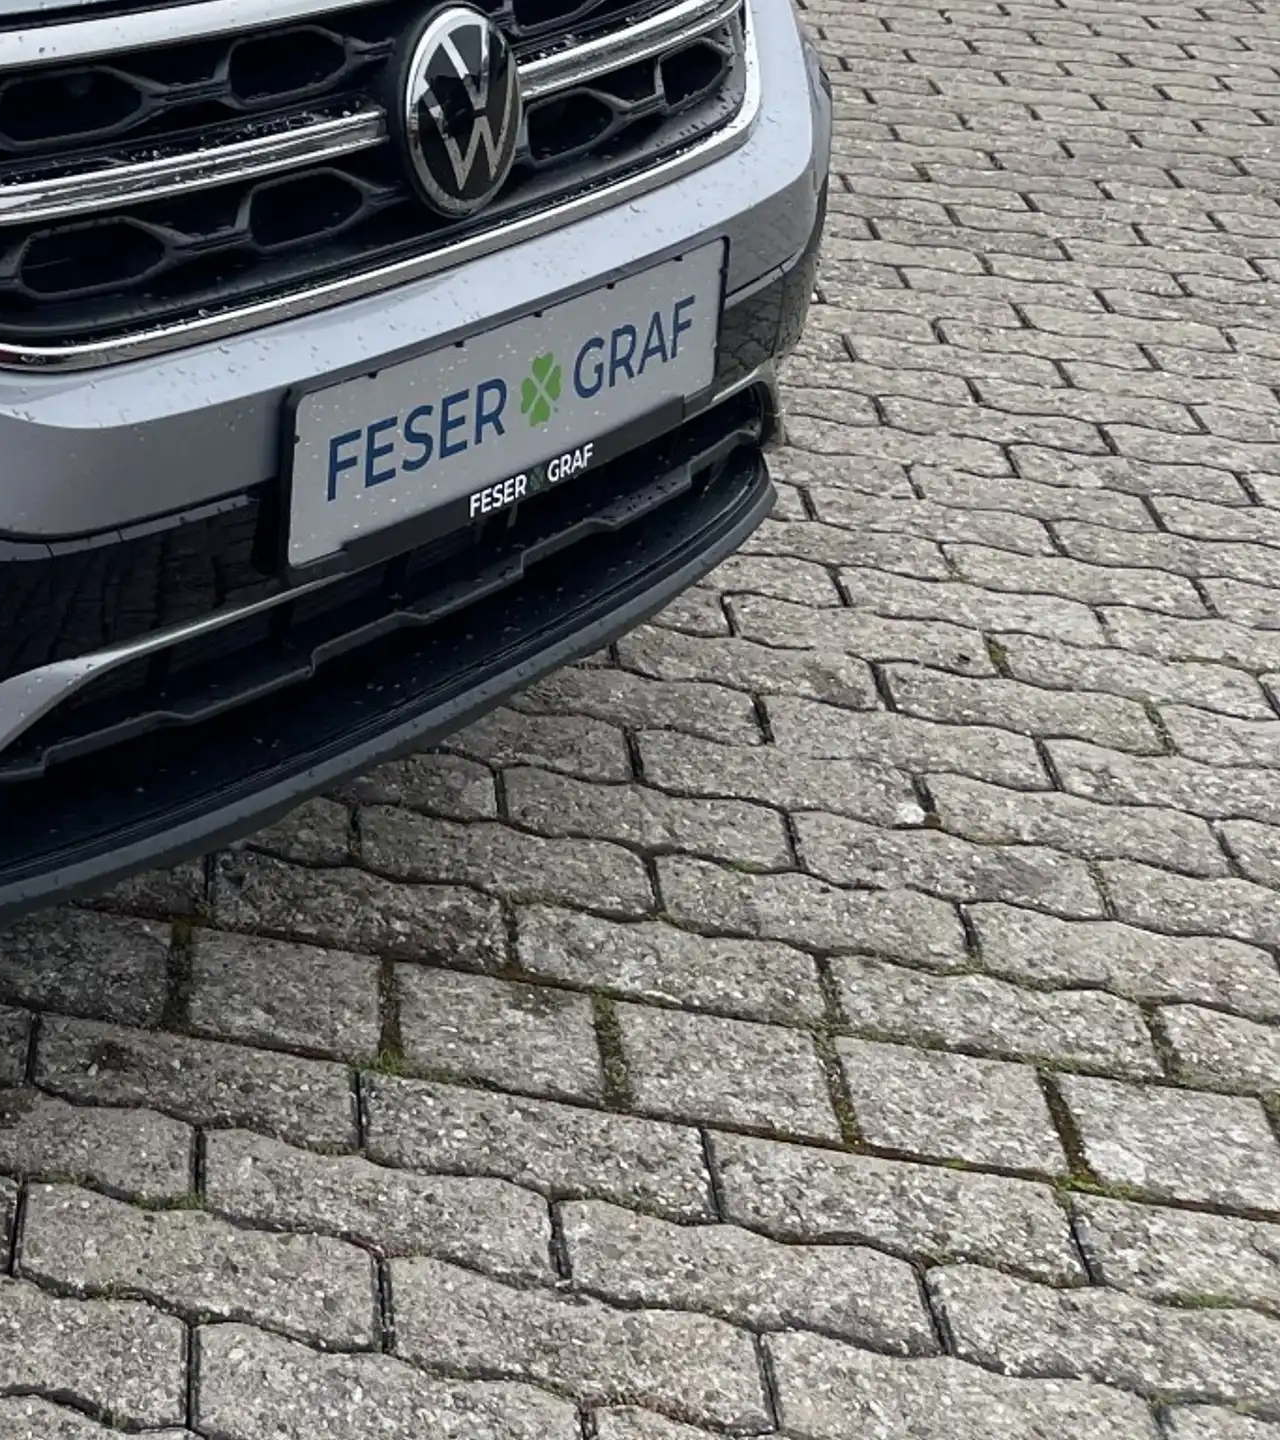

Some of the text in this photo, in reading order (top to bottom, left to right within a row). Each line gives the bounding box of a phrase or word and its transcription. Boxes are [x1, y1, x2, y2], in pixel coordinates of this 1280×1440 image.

[406, 6, 522, 216] VW
[326, 296, 696, 502] FESER GRAF
[469, 442, 594, 518] FESER GRAF
